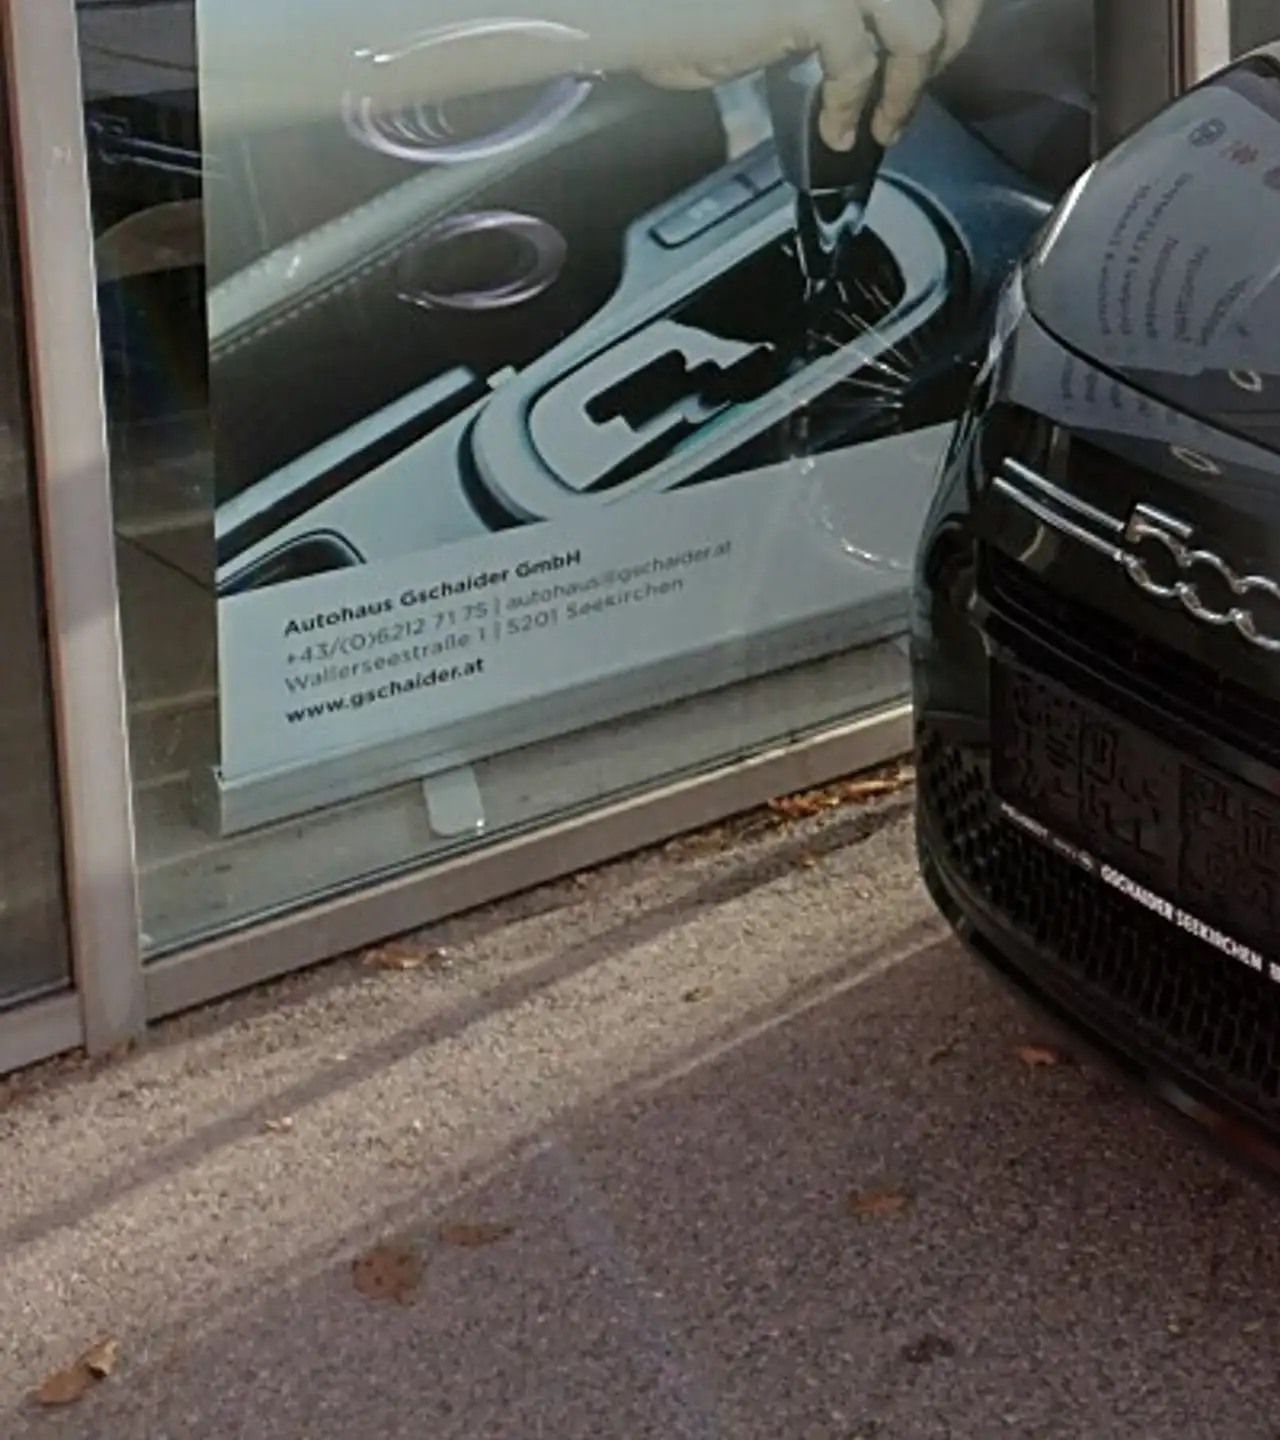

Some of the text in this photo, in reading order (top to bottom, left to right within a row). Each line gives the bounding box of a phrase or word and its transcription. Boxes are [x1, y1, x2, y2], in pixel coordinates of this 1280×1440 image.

[284, 548, 581, 638] Autohaus Gschaider GmbH
[507, 608, 558, 635] 5201
[565, 577, 684, 620] Seekirchen
[285, 657, 485, 724] www.gschaider.at
